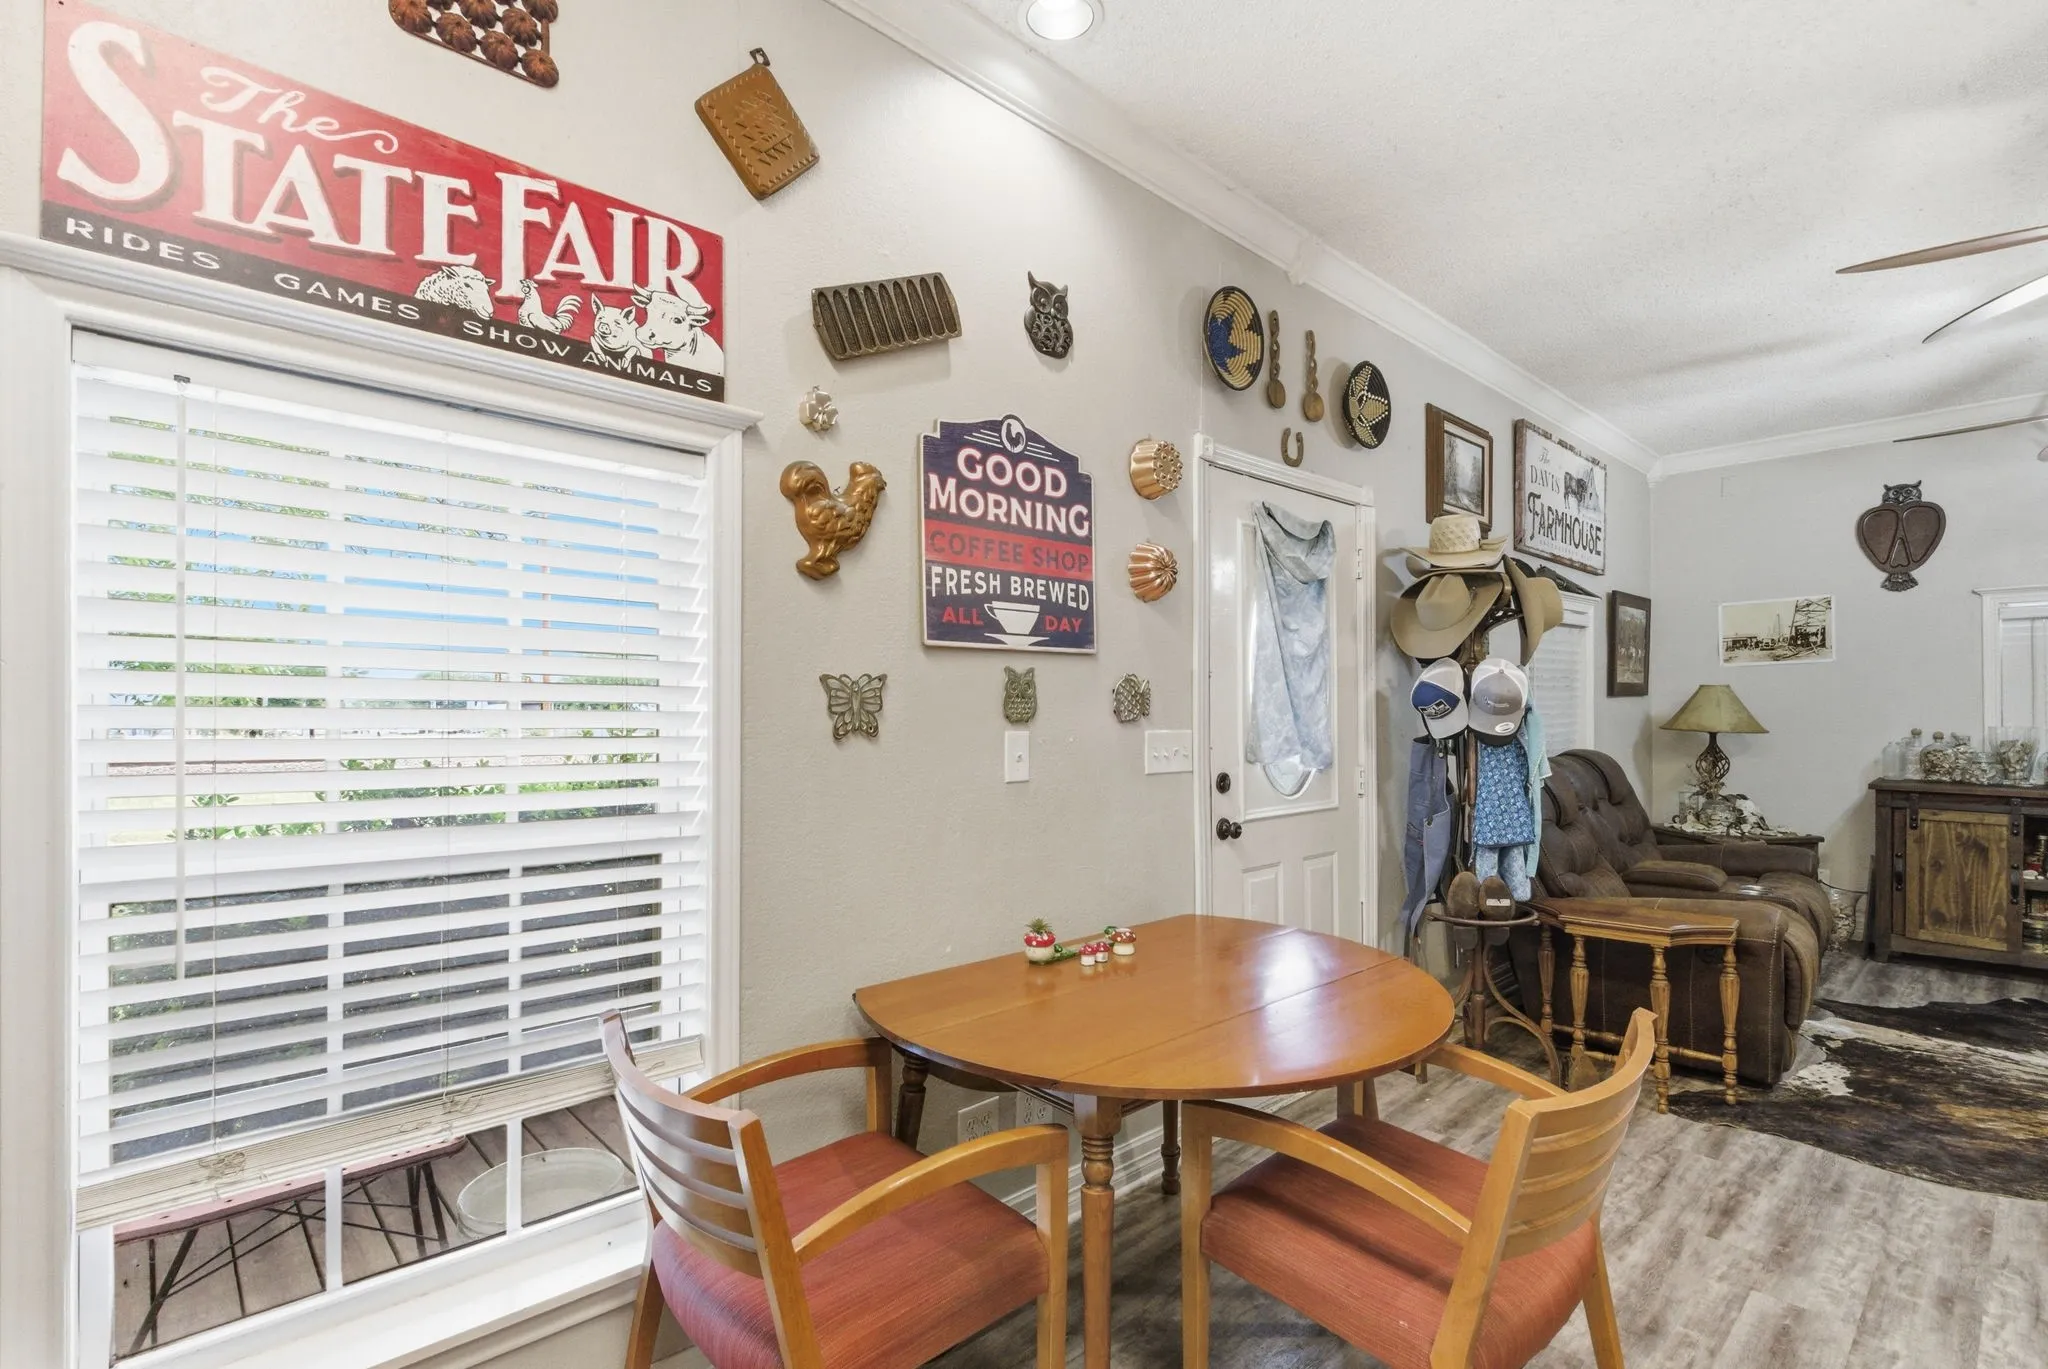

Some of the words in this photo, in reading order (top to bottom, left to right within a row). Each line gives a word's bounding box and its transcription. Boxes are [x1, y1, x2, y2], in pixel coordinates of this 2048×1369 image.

[200, 66, 398, 153] The
[57, 21, 478, 265] STATE
[495, 172, 712, 314] FAIR
[65, 216, 221, 270] RIDES
[273, 272, 420, 320] GAMES
[462, 320, 570, 357] SHOW
[582, 351, 712, 393] ANIMALS
[957, 447, 1067, 498] GOOD
[1530, 464, 1560, 495] DAVIS
[928, 472, 1090, 537] MORNING
[1527, 491, 1602, 556] FARMHOUSE
[929, 530, 1024, 565] COFFEE
[1032, 546, 1089, 573] SHOP
[931, 565, 1001, 597] FRESH
[1010, 575, 1090, 611] BREWED
[942, 606, 984, 625] ALL
[1044, 614, 1083, 633] DAY
